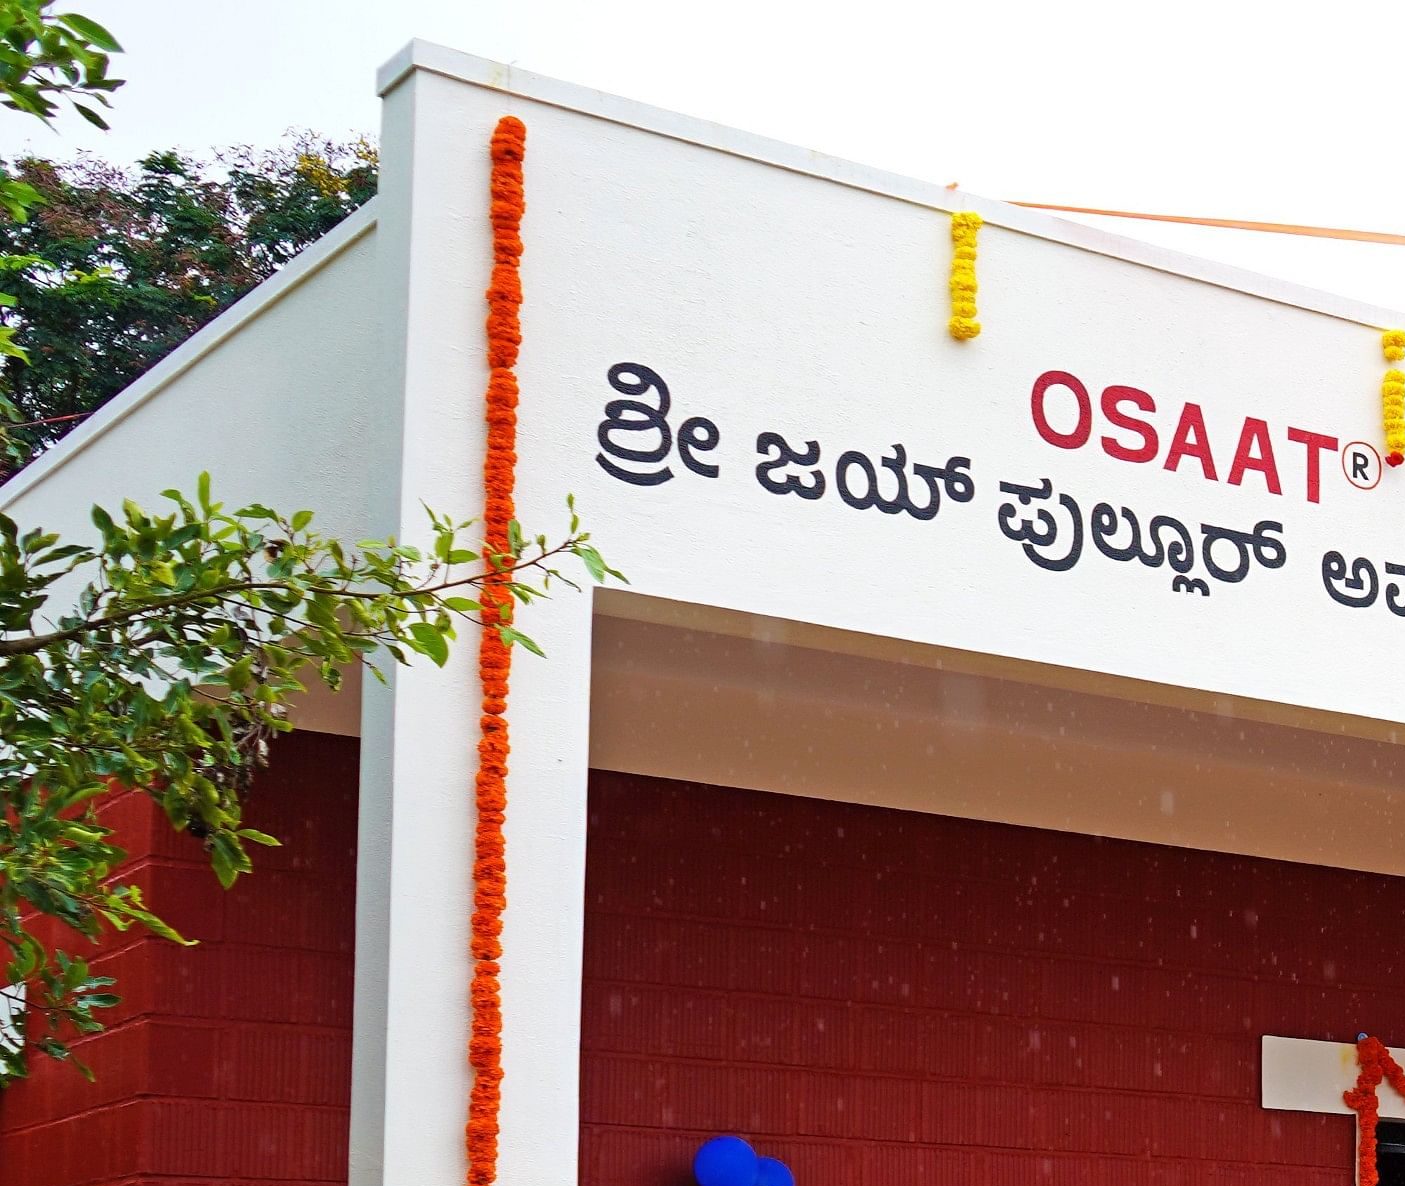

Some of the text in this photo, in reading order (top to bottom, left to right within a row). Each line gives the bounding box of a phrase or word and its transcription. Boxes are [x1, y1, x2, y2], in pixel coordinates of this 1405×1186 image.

[596, 362, 720, 485] ಶ್ರೀ
[755, 429, 975, 521] ಜಯ್
[998, 478, 1287, 596] ಪುಲ್ಲೂರ್
